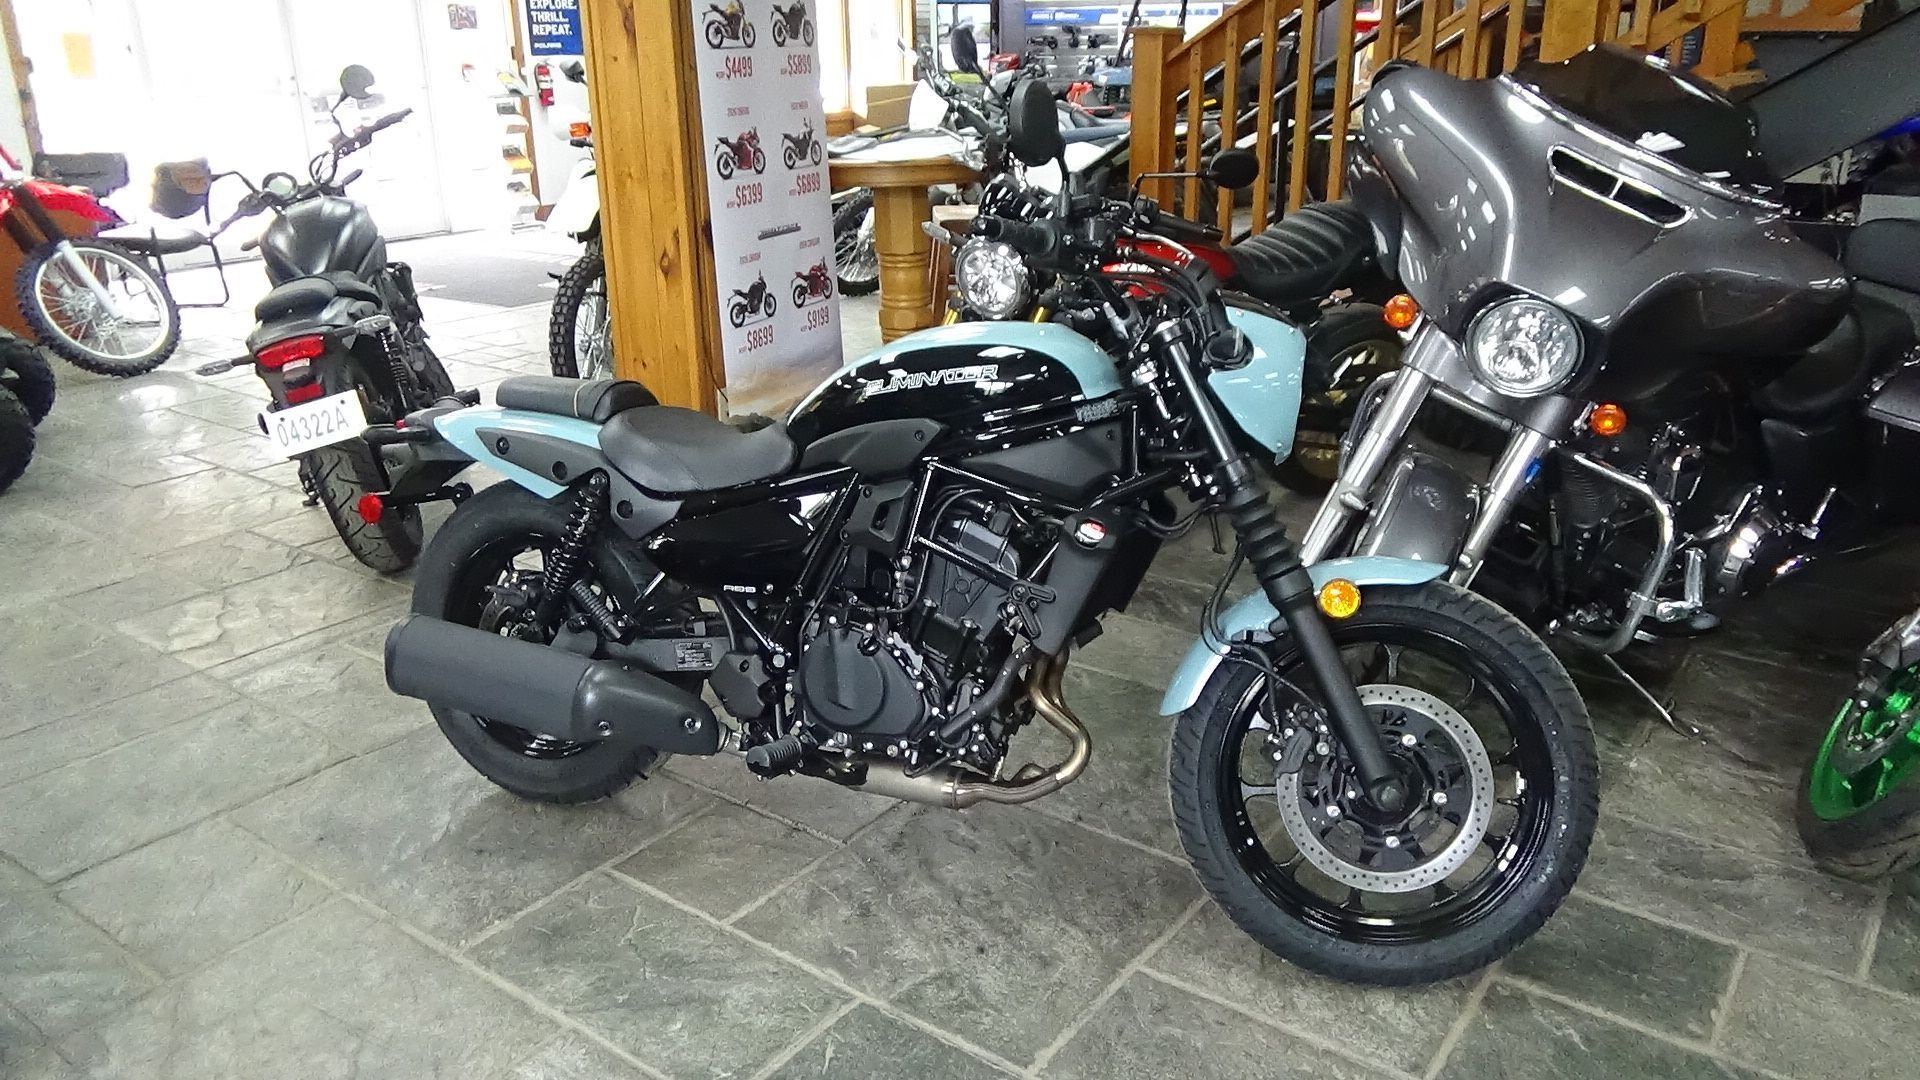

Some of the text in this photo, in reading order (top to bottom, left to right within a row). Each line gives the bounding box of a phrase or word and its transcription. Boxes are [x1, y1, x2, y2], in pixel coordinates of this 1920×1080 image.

[531, 11, 569, 23] THRILL.
[532, 24, 573, 36] REPEAT.
[725, 56, 753, 80] $4499
[735, 182, 763, 209] $6399
[747, 324, 774, 352] $8699
[865, 364, 999, 397] ELIMINATOR
[277, 406, 349, 447] 04322A
